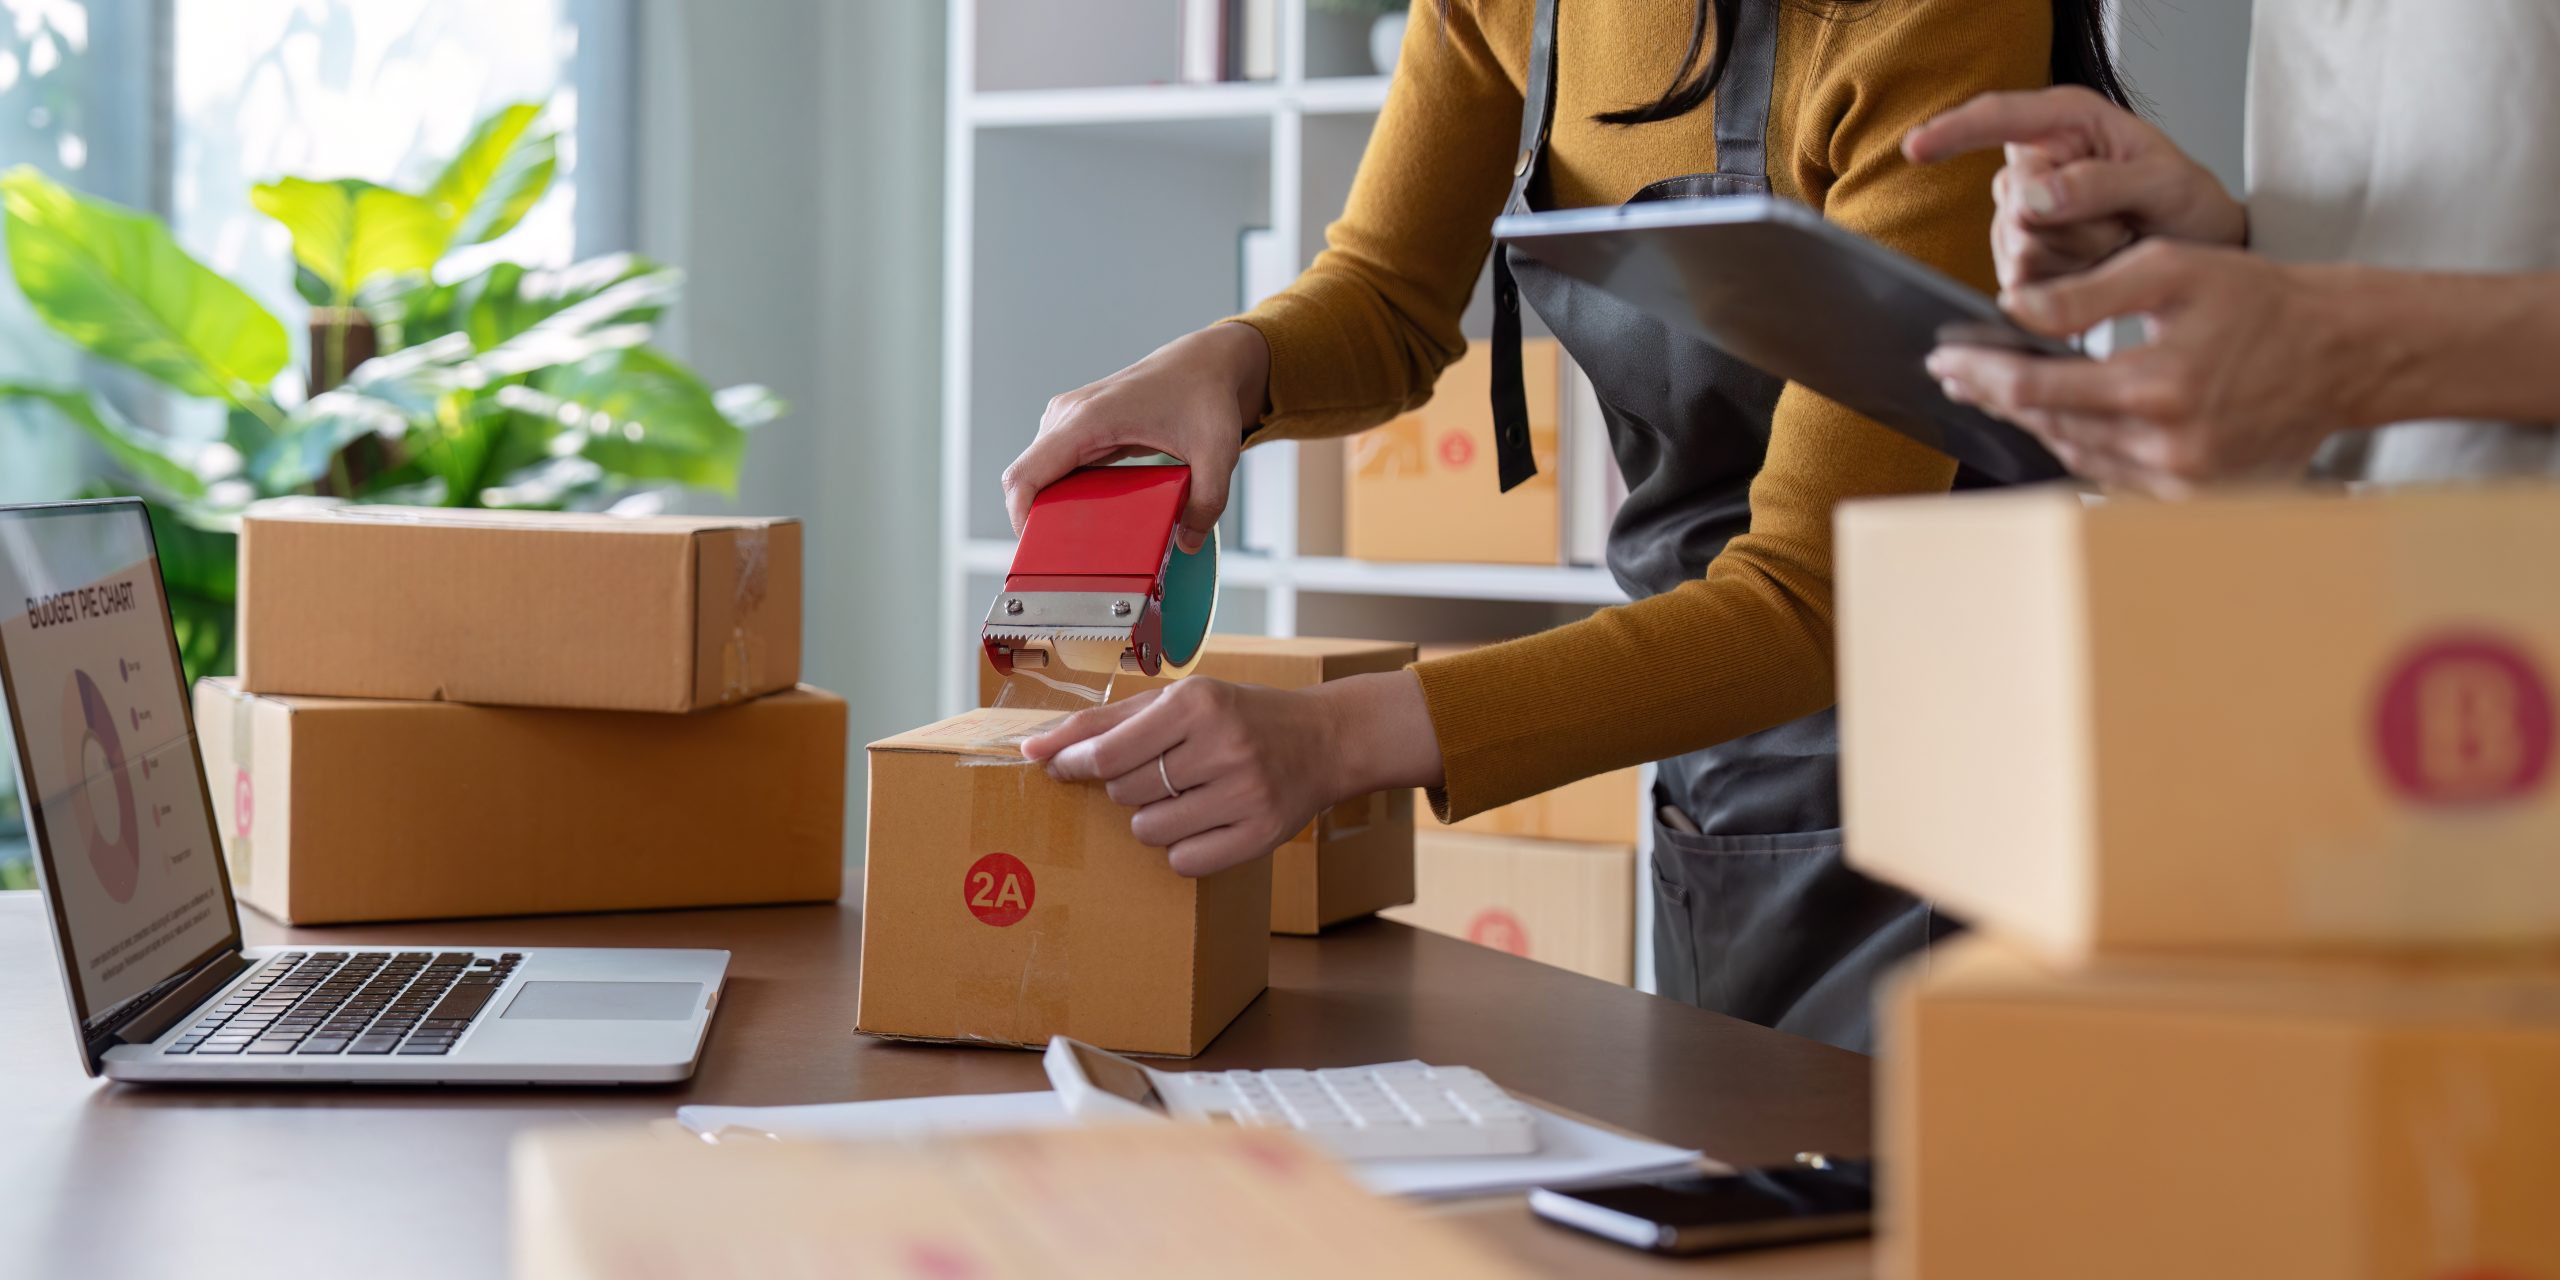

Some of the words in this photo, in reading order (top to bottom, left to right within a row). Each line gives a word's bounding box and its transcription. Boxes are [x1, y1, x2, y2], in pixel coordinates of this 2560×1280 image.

[25, 590, 78, 629] BUDGET
[78, 587, 100, 619] PIE
[98, 581, 136, 615] CHART
[971, 871, 1027, 910] 2A
